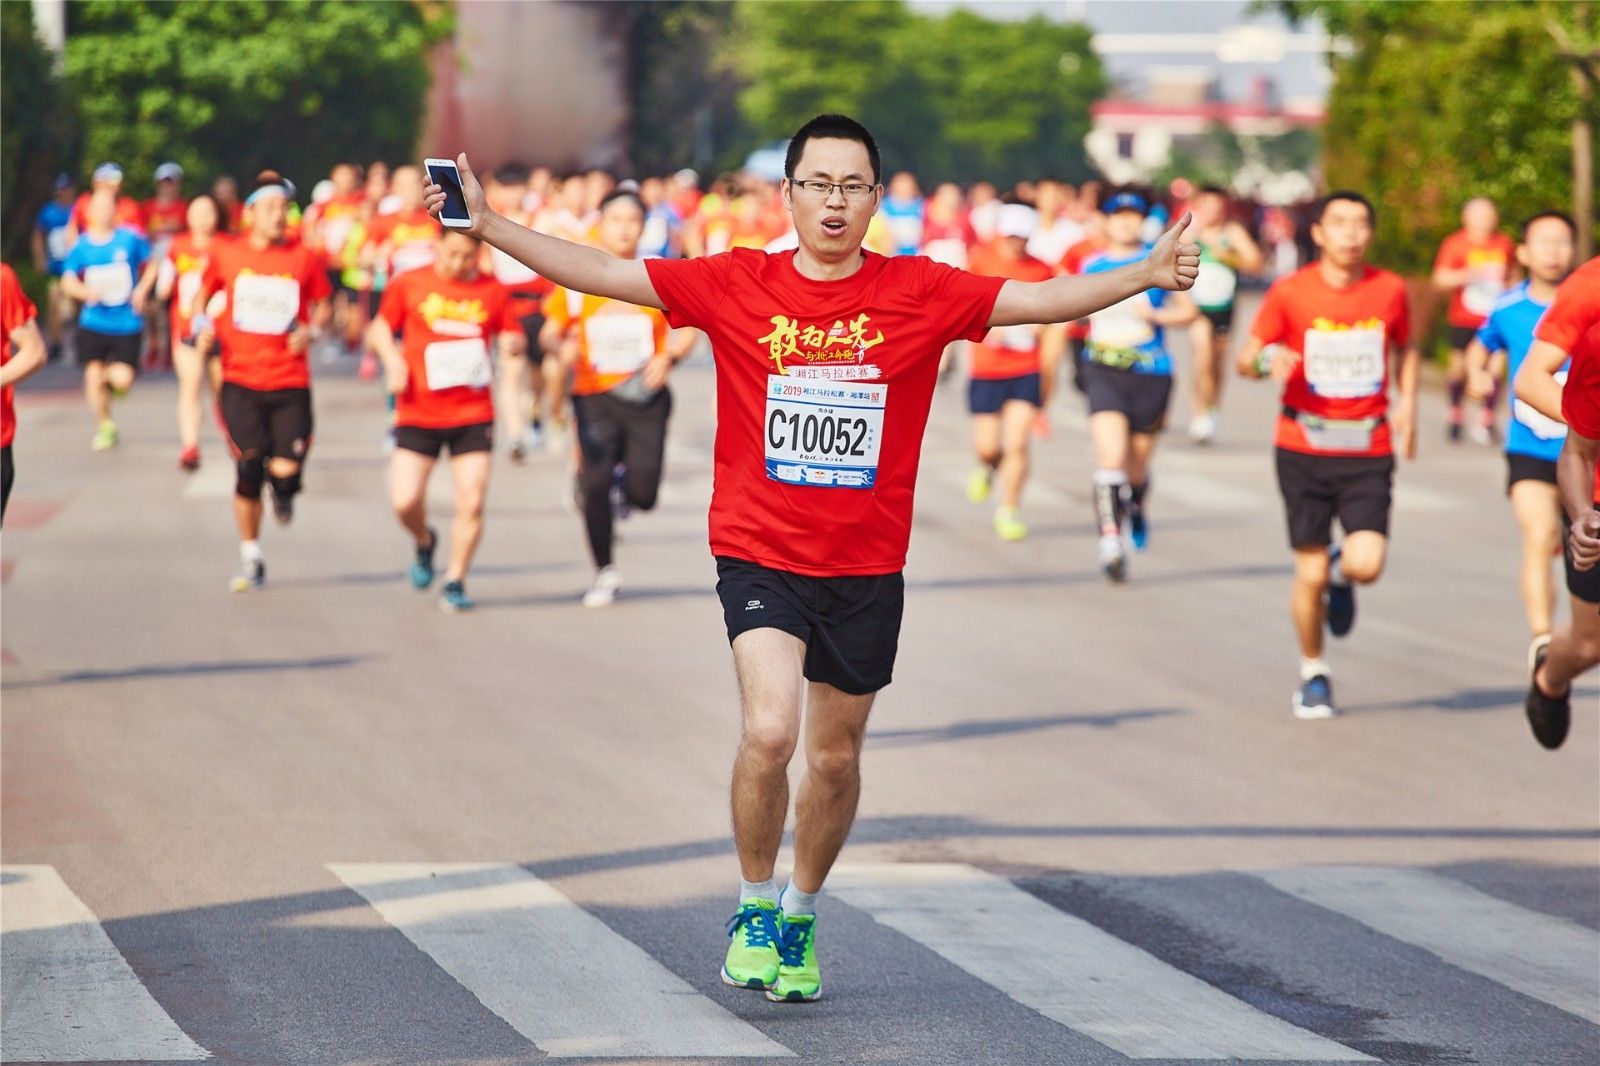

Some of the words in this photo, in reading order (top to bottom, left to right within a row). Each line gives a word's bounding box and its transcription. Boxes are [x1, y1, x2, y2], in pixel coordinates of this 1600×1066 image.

[757, 313, 885, 375] 敢为人先
[796, 367, 869, 379] 湘江马拉松赛
[783, 385, 802, 396] 2019
[768, 409, 867, 457] C10052
